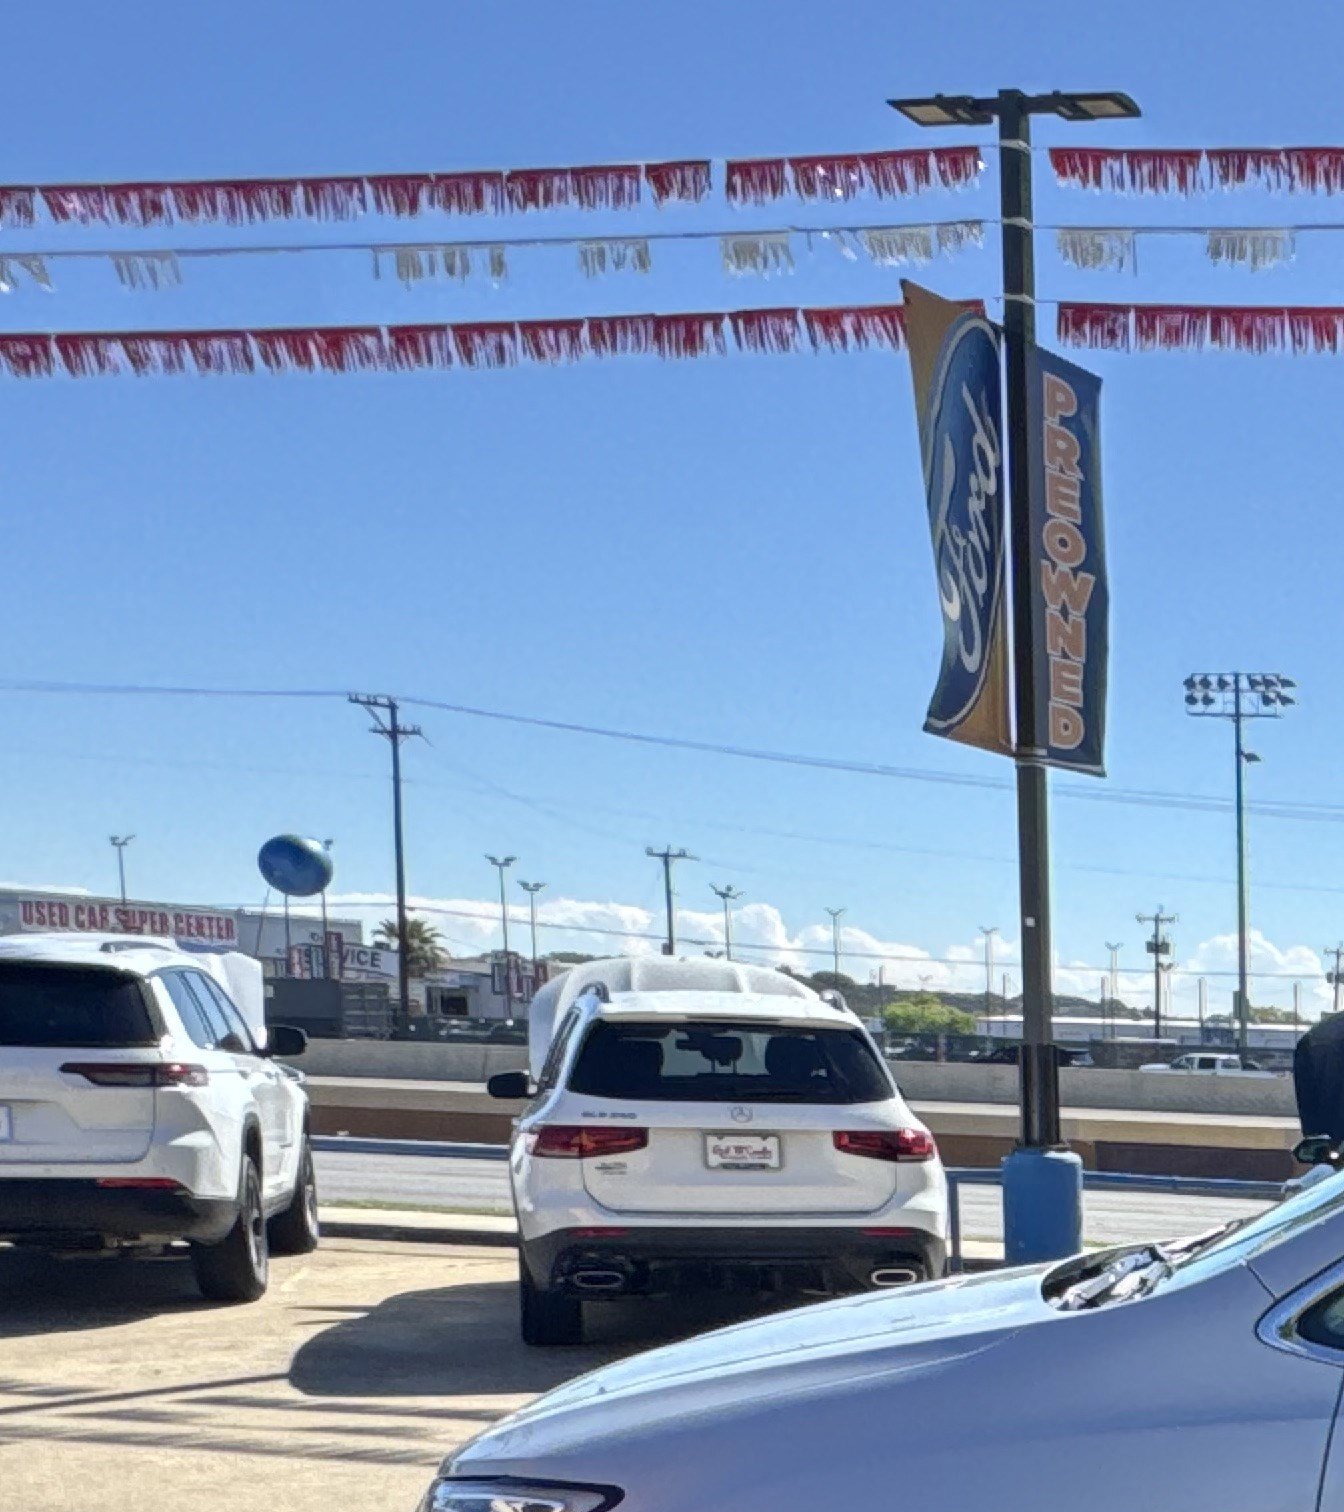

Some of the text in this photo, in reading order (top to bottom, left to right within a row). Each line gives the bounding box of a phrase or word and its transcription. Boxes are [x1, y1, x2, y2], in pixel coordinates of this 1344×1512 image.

[939, 381, 1001, 675] Ford
[1041, 371, 1095, 750] PREOWNED
[22, 900, 70, 927] USED
[75, 902, 109, 929] CAR
[174, 912, 236, 940] CENTER
